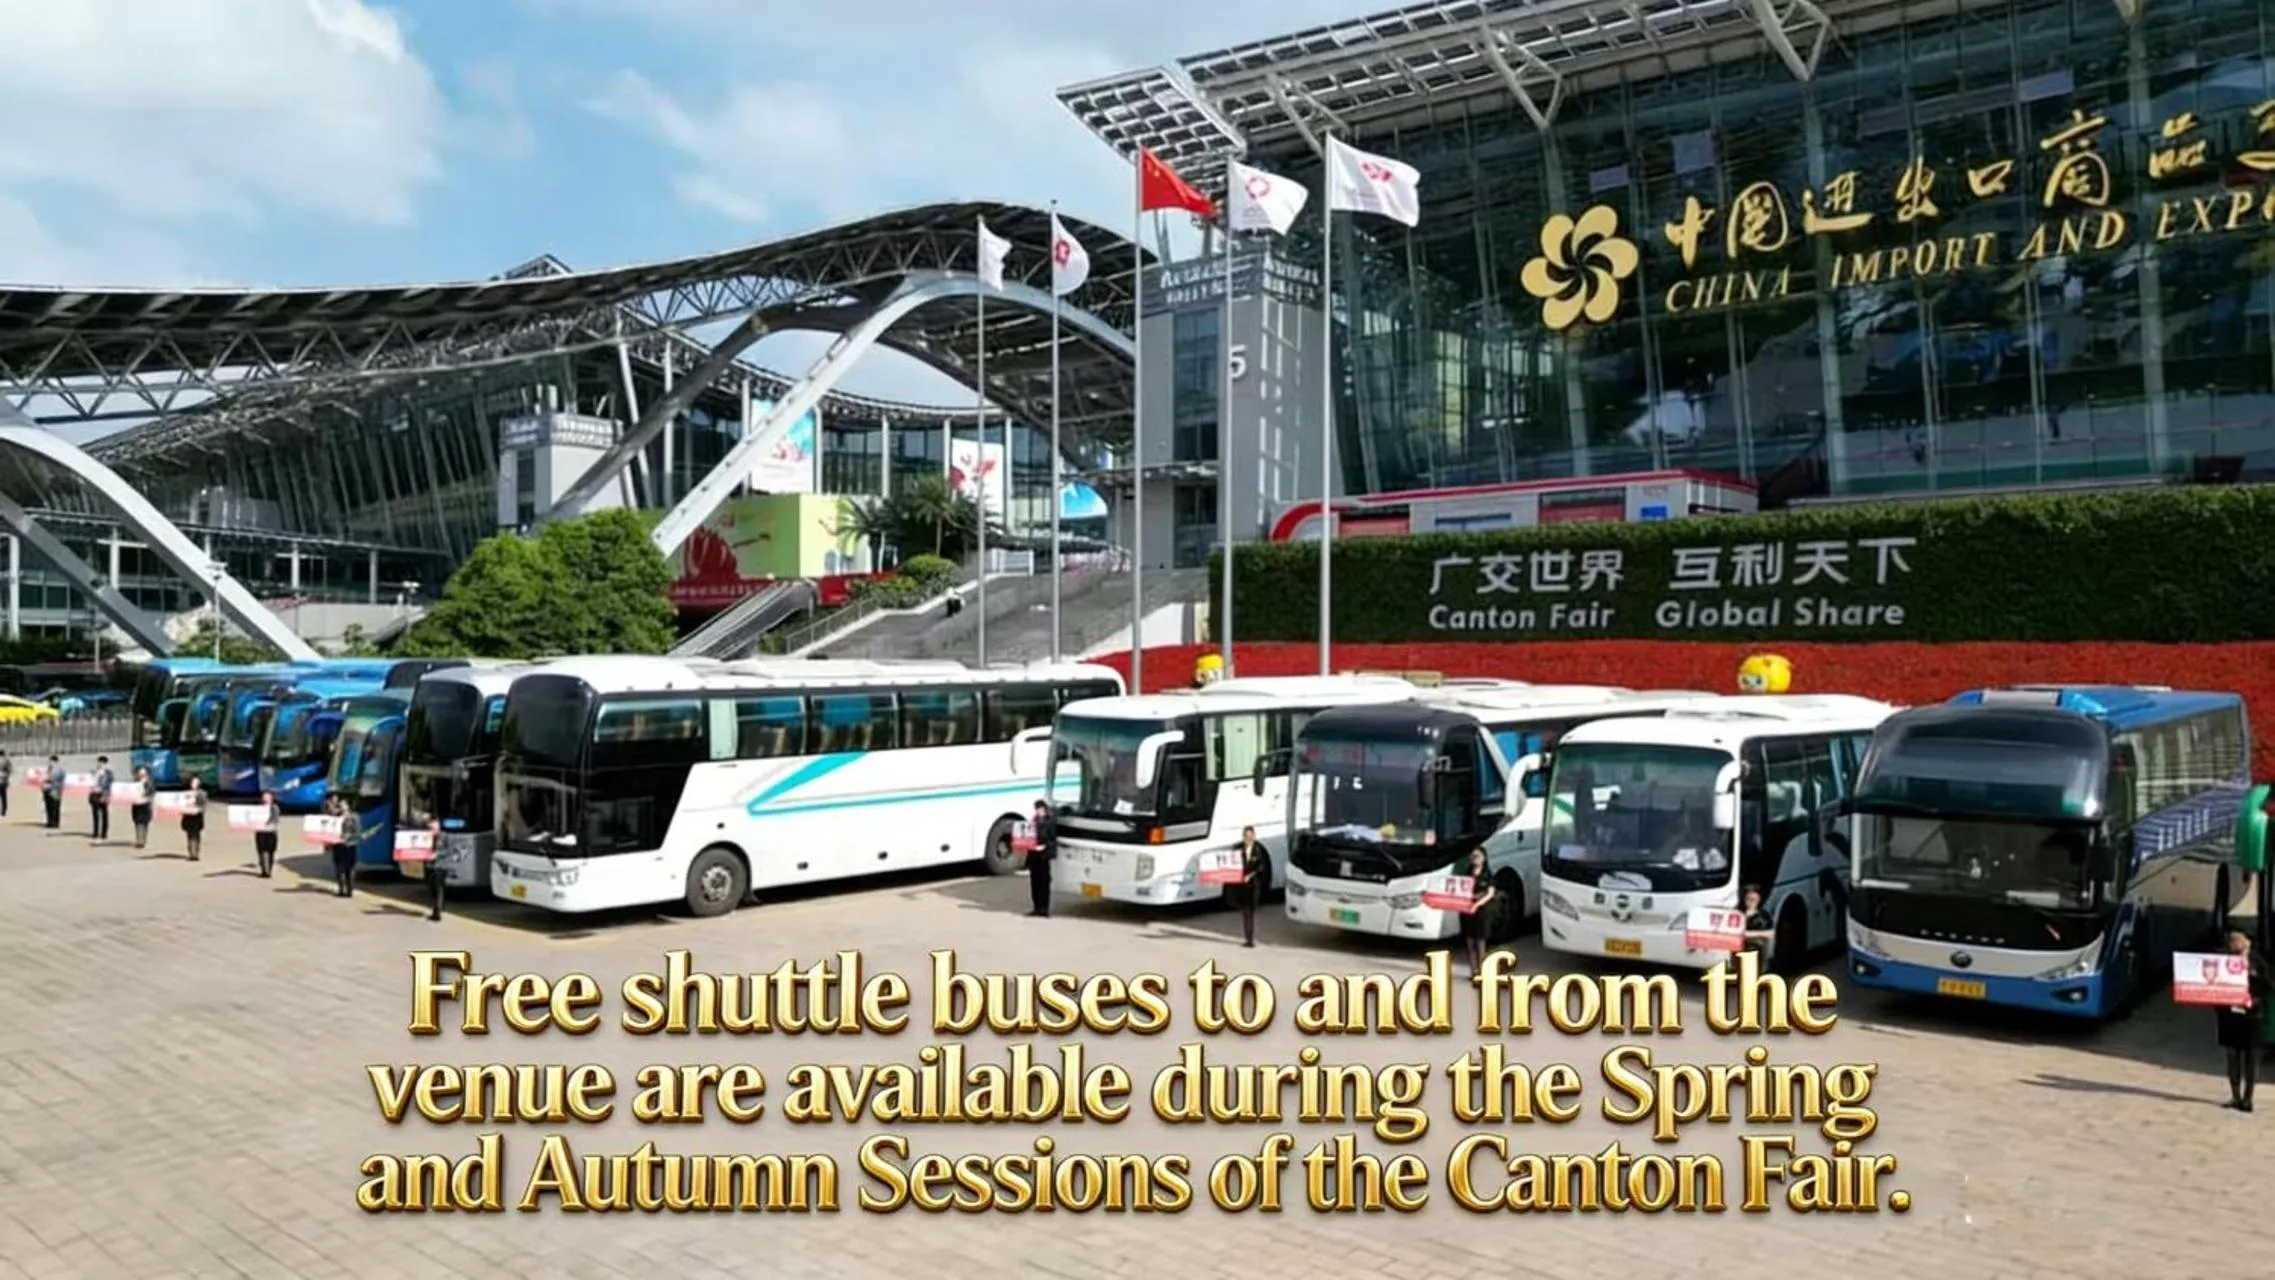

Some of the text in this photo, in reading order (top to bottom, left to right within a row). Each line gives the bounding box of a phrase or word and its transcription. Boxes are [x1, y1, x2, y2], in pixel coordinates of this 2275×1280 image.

[1665, 263, 1790, 313] CHINA
[1831, 232, 1996, 289] IMPORT
[2017, 210, 2126, 260] AND
[1429, 537, 1917, 594] 广交世界 互利天下
[1429, 597, 1906, 630] Canton Fair Global Share
